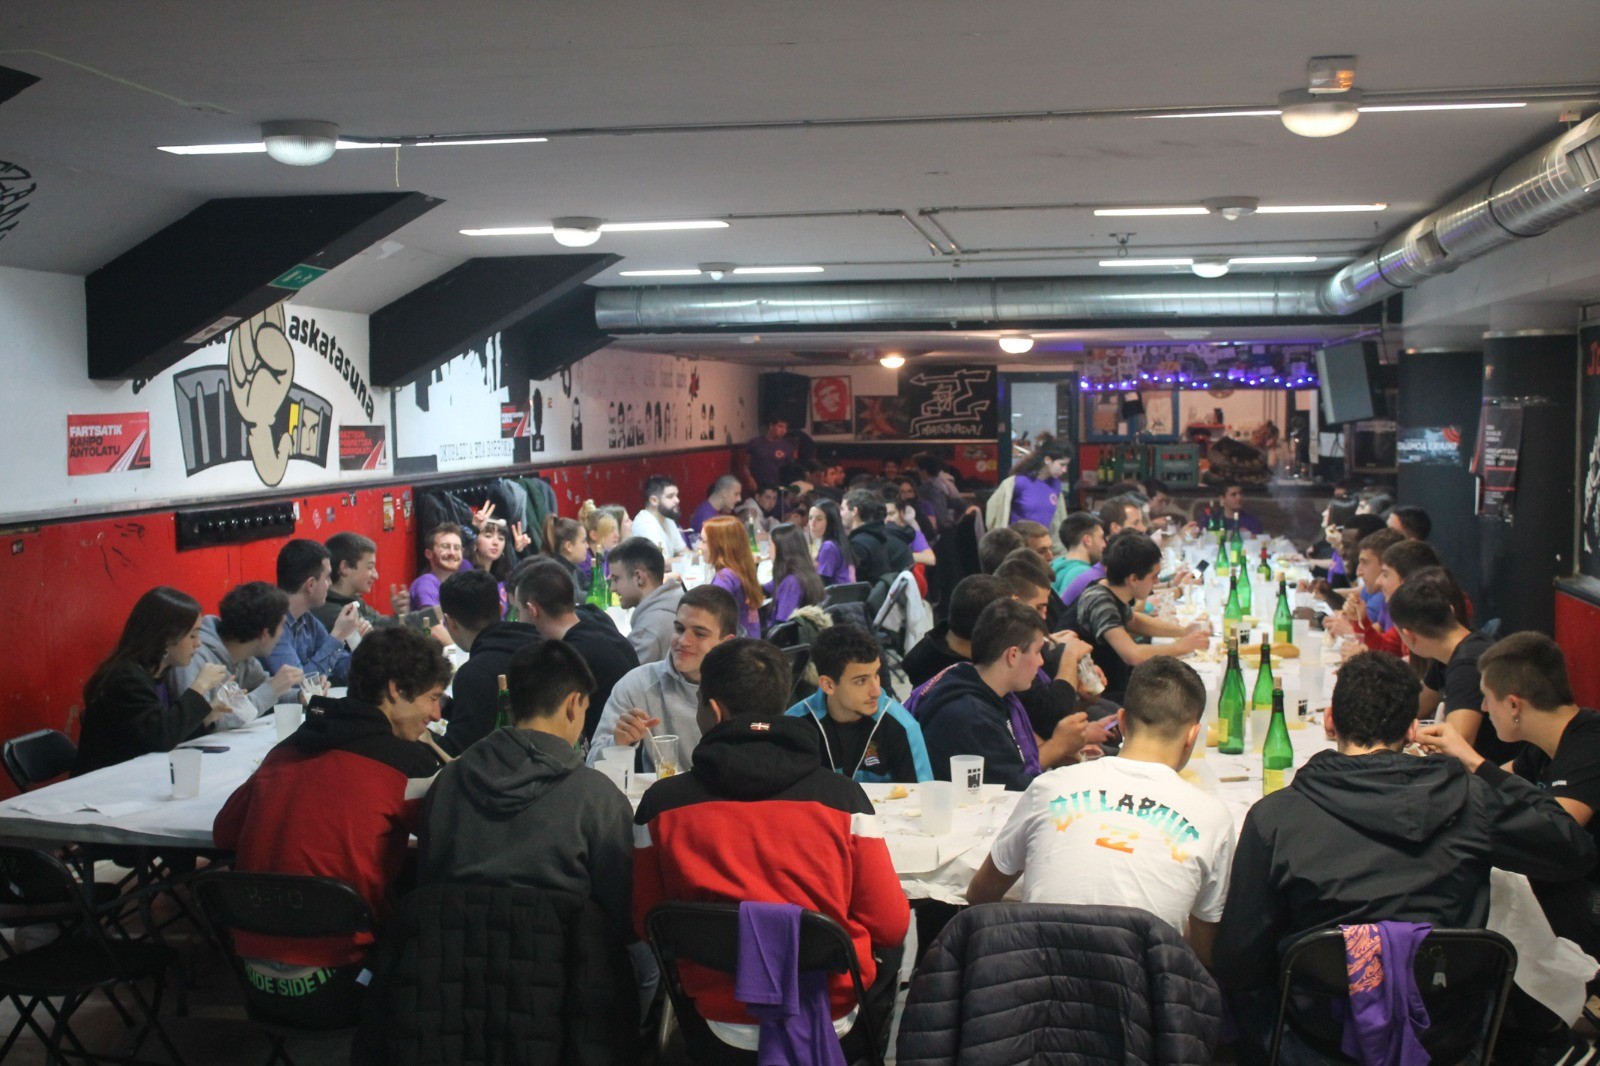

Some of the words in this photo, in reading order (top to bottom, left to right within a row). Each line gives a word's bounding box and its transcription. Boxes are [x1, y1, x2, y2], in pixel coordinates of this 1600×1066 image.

[288, 315, 374, 424] askatasuna
[69, 424, 123, 438] FARTSATIK
[69, 435, 103, 448] KANPO
[69, 445, 121, 458] ANTOLATU
[278, 972, 317, 997] SIDE
